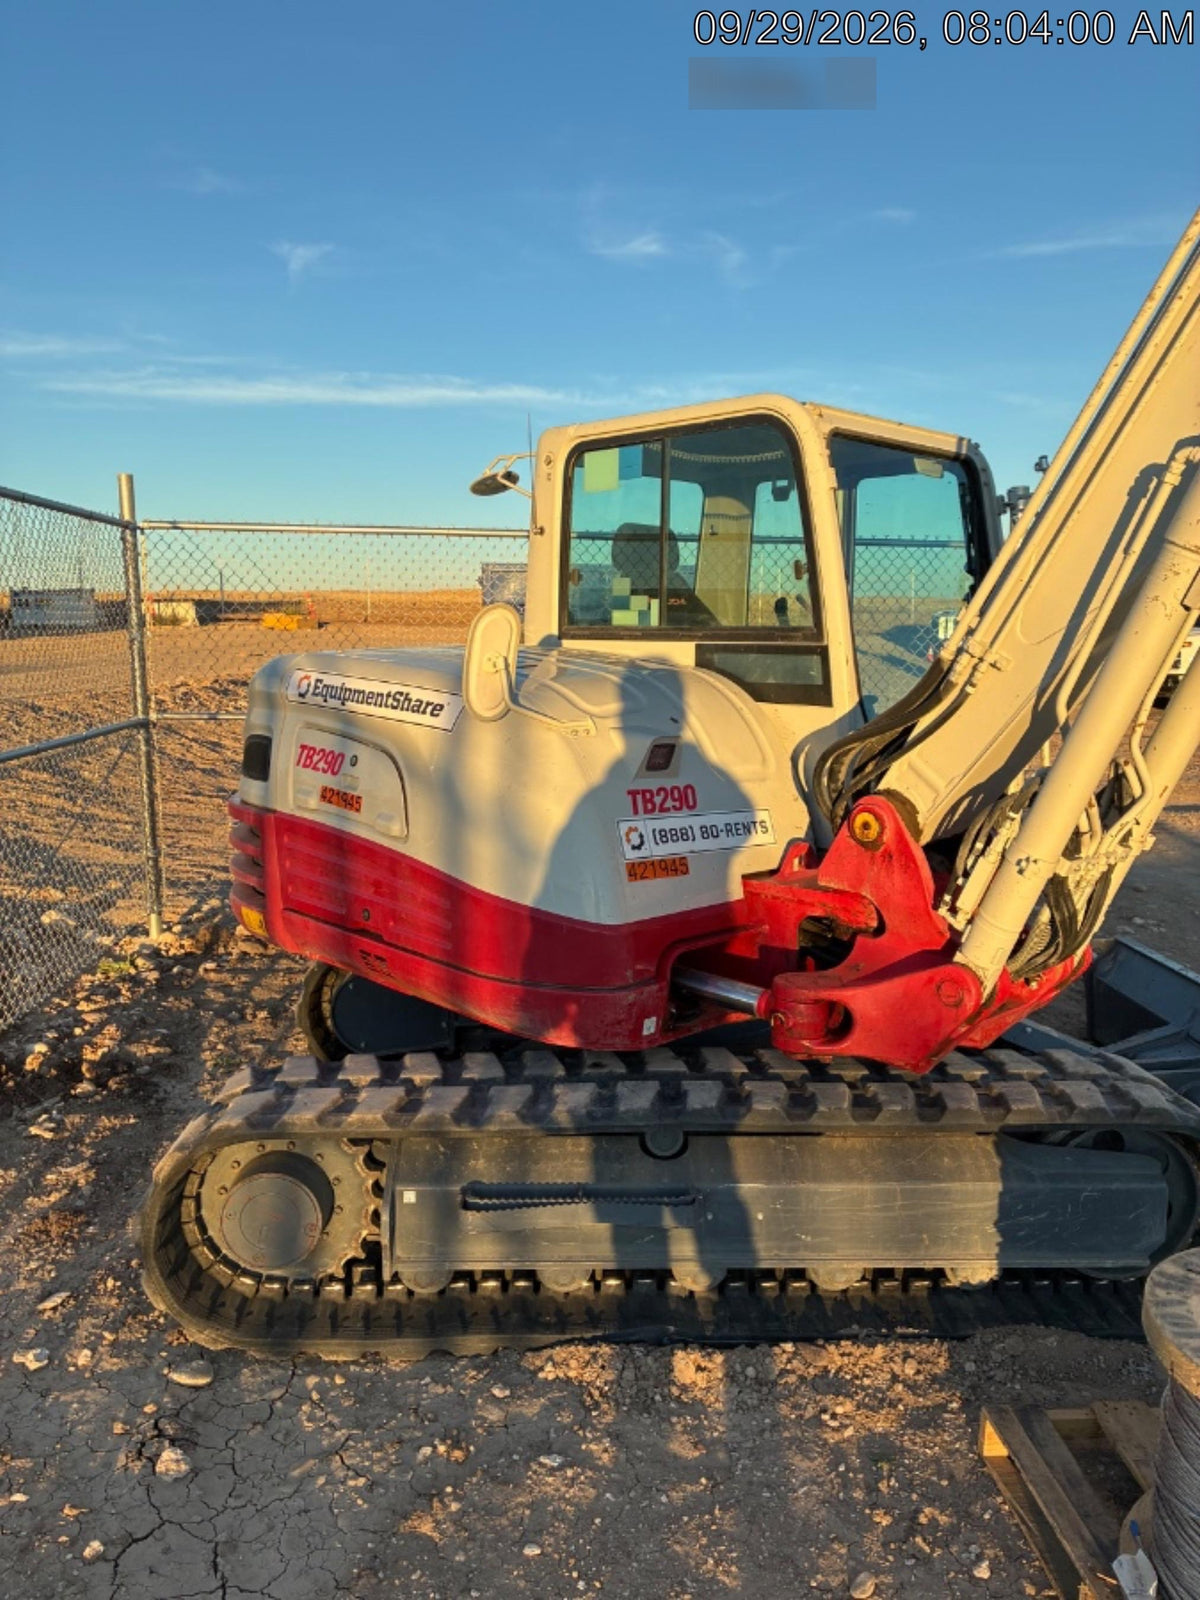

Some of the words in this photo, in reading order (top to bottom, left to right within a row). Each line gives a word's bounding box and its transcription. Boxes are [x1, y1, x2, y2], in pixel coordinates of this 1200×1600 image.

[311, 679, 445, 717] EquipmentShare
[296, 744, 345, 776] TB290
[320, 786, 362, 812] 421945
[627, 784, 697, 816] TB290
[628, 857, 689, 880] 421945
